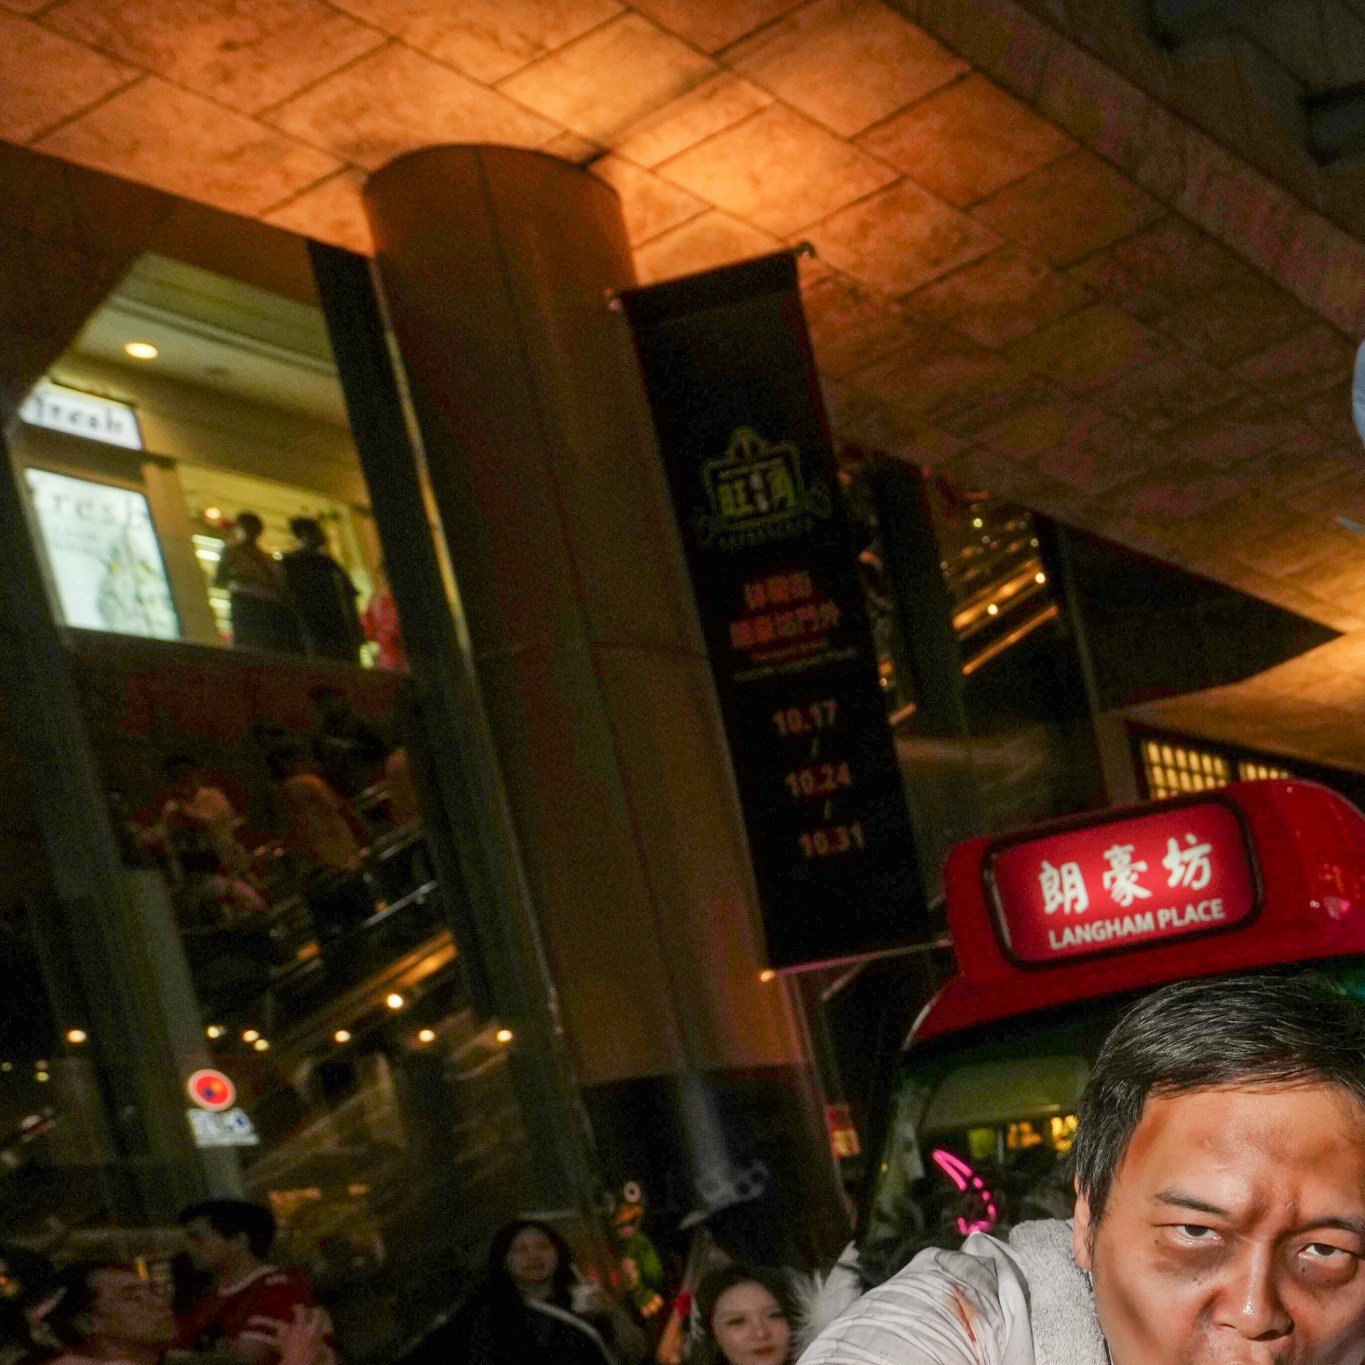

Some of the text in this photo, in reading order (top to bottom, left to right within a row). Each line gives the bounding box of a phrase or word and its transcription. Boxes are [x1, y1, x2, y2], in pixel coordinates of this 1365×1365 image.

[771, 697, 838, 738] 10.17
[784, 760, 852, 798] 10.24
[798, 818, 866, 859] 10.31
[1038, 832, 1213, 916] 朗豪坊
[1048, 897, 1226, 950] LANGHAM PLACE
